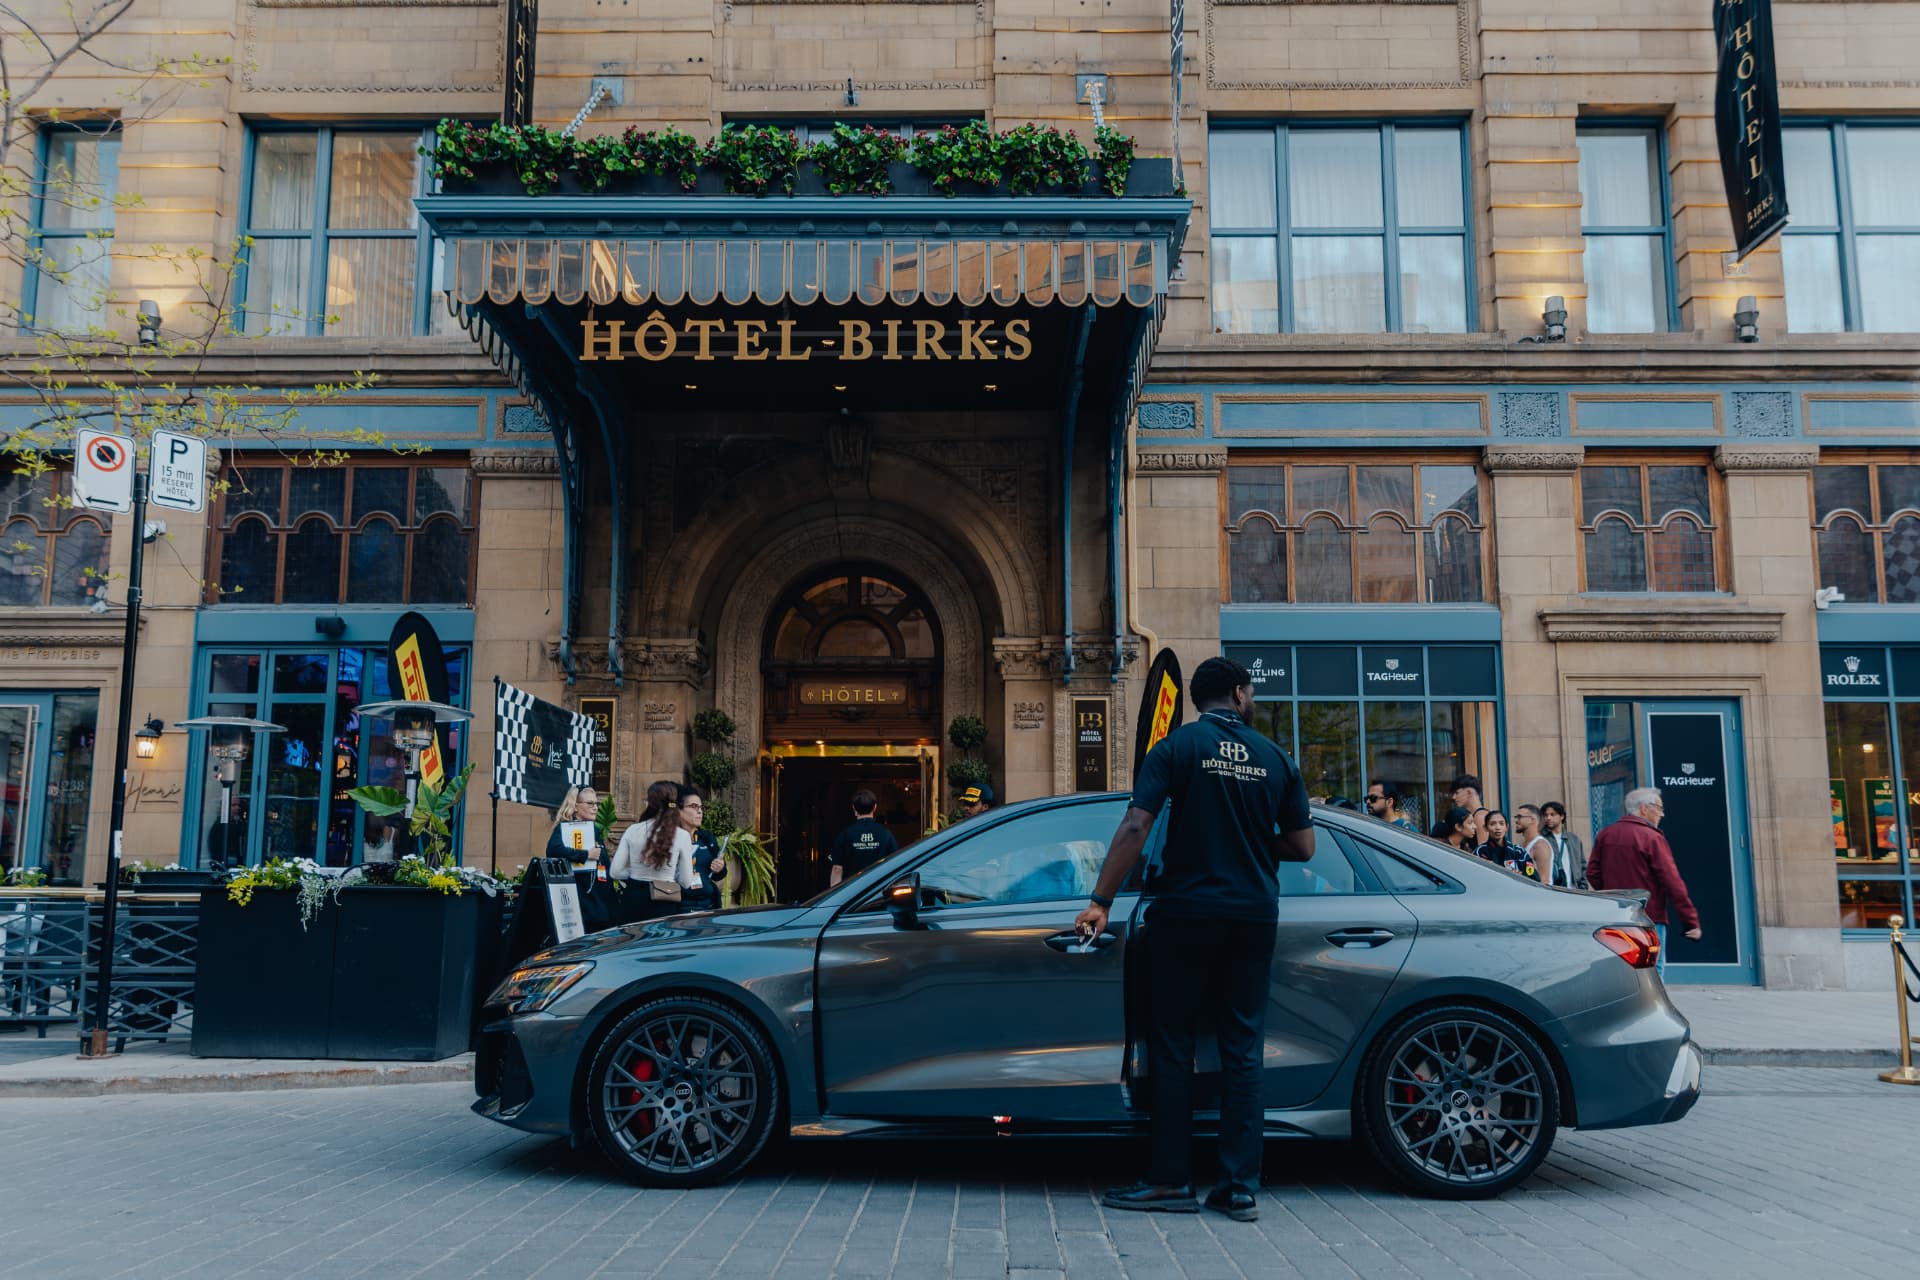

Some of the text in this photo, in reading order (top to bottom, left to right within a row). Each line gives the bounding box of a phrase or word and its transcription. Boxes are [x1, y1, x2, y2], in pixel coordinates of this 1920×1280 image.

[579, 310, 1032, 361] HÔTEL BIRKS
[169, 438, 188, 464] P
[162, 465, 194, 481] 15 min
[1826, 673, 1881, 685] ROLEX
[821, 685, 886, 702] HÔTEL
[1202, 757, 1268, 777] HÔTEL BIRKS
[126, 771, 182, 813] Henri
